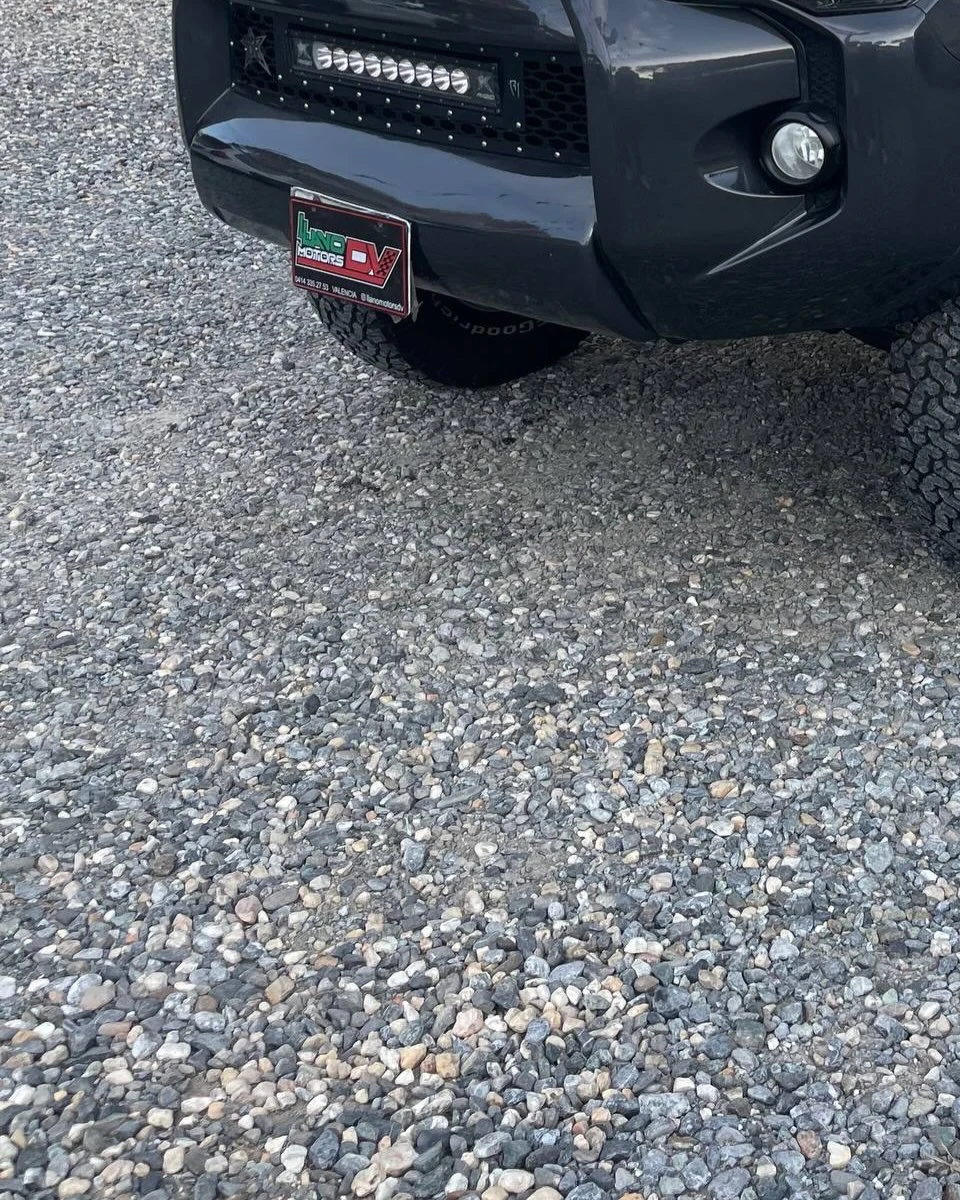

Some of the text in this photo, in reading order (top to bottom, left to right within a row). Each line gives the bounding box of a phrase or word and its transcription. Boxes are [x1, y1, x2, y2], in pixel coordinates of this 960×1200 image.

[297, 211, 402, 279] LLANO DV
[297, 246, 344, 267] MOTORS
[332, 285, 357, 298] VALENCIA
